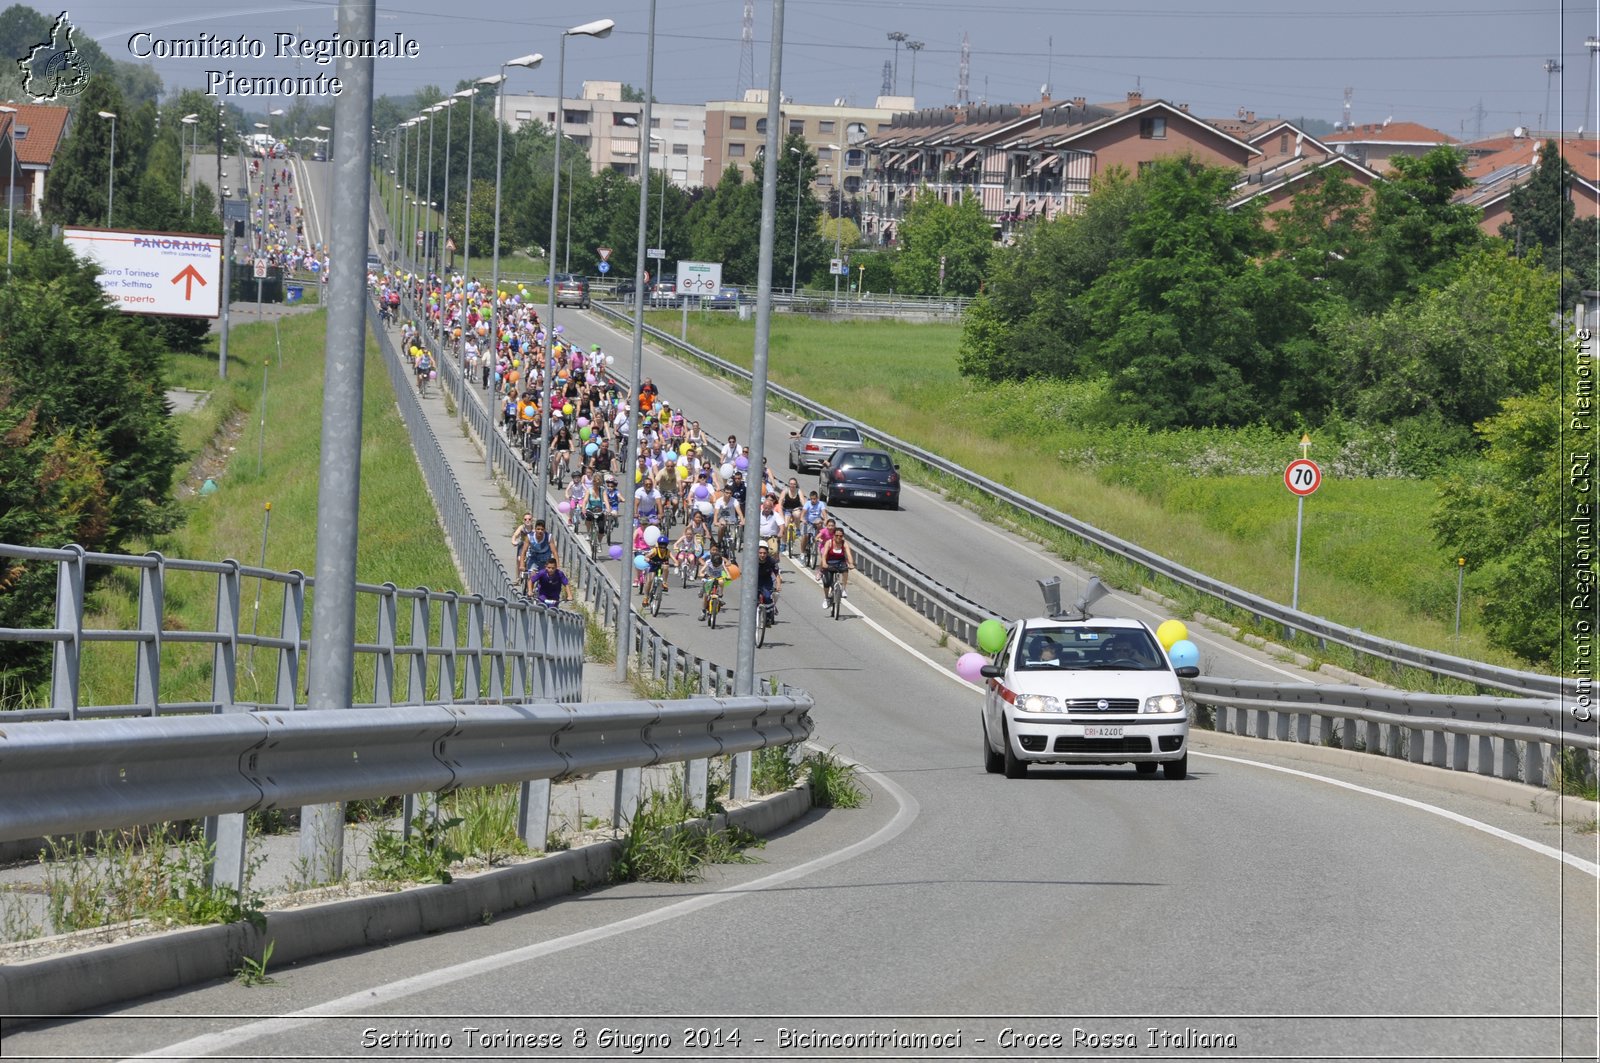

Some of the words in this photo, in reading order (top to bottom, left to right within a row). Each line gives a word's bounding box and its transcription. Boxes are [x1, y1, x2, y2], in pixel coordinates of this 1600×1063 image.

[134, 237, 211, 252] PANORAMA
[125, 268, 160, 278] Torinese
[104, 280, 118, 288] per
[122, 279, 152, 289] Settimo
[123, 295, 155, 304] aperto
[1294, 468, 1313, 486] 70
